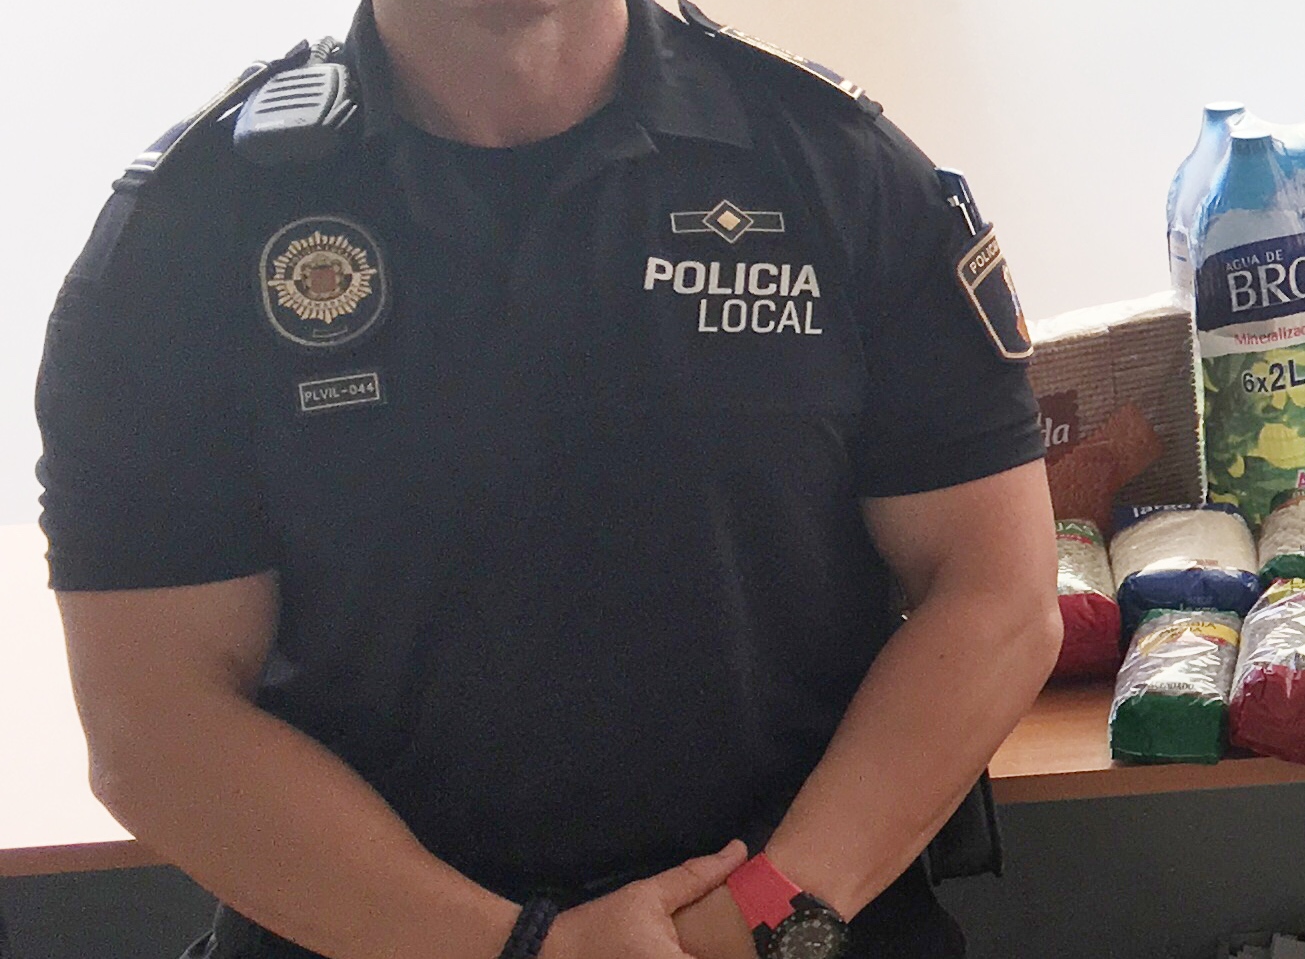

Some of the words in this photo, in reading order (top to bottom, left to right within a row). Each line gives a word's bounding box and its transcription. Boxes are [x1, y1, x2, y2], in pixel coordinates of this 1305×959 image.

[1225, 254, 1261, 272] AGUA
[1266, 249, 1284, 262] DE
[643, 256, 821, 298] POLICIA
[698, 299, 823, 334] LOCAL
[304, 382, 374, 403] PLVIL-044
